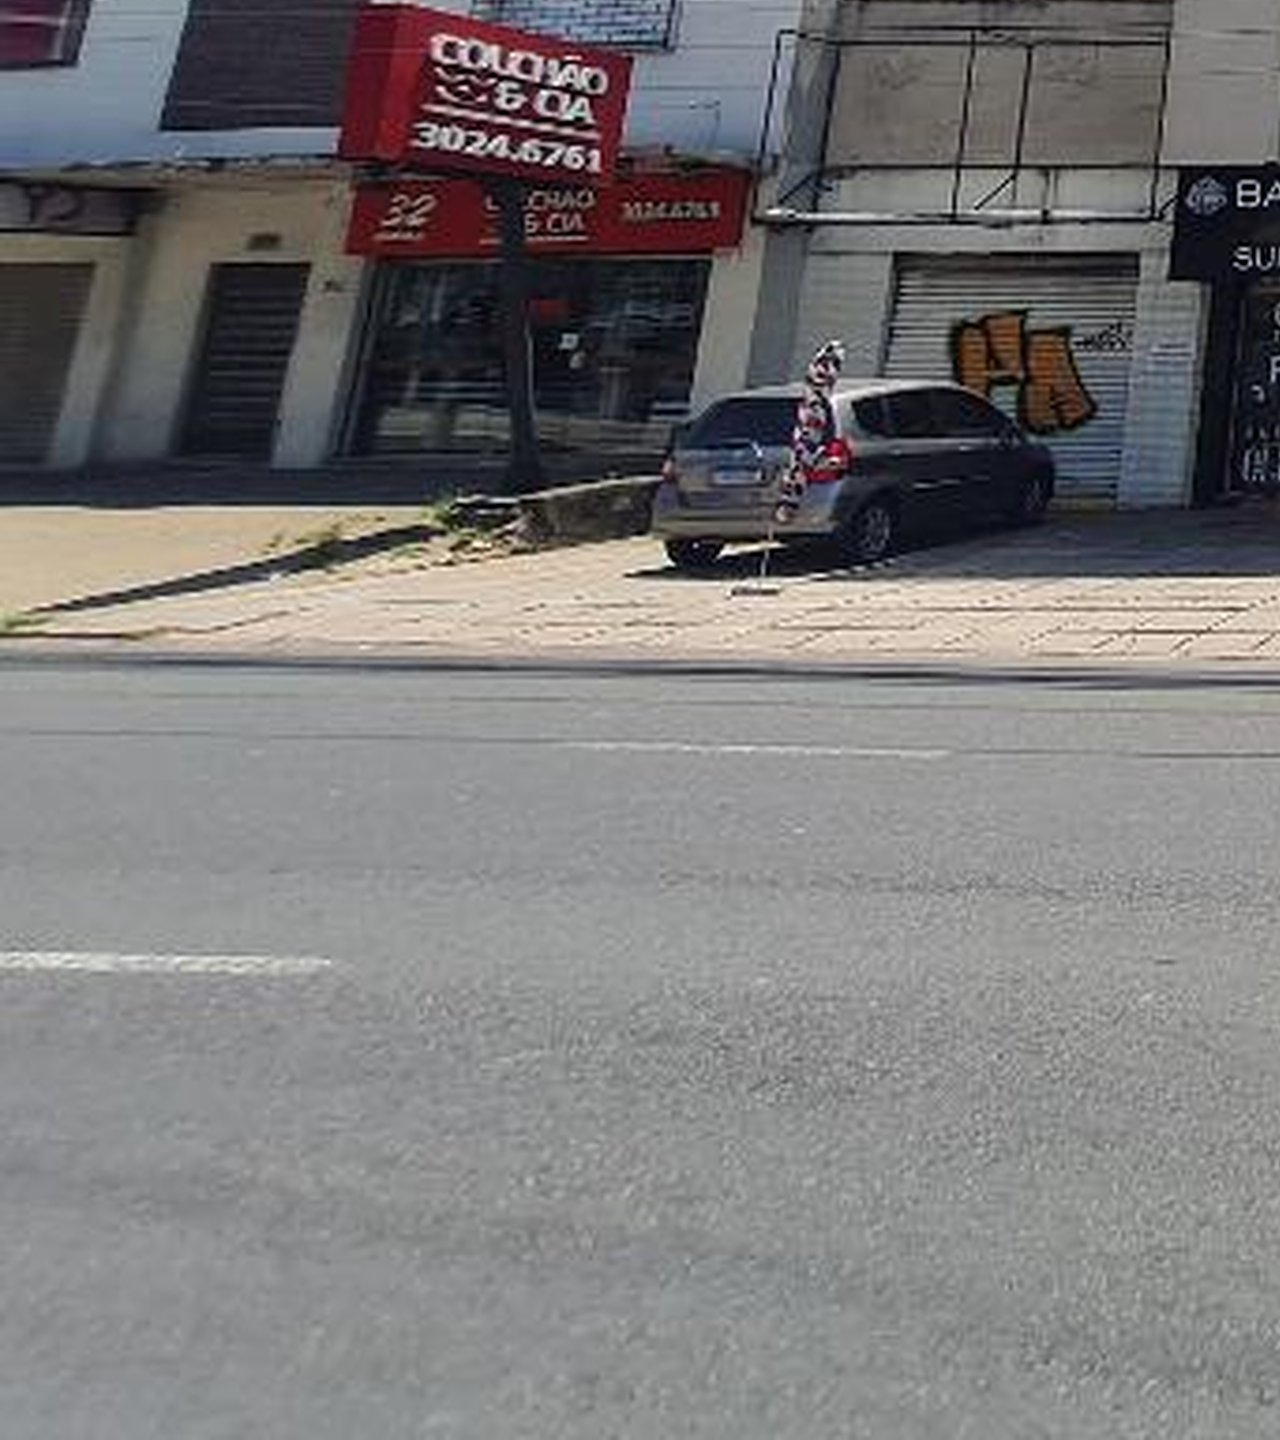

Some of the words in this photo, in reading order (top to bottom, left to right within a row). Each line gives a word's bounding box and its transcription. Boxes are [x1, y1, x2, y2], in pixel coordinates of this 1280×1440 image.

[430, 33, 608, 96] COLCHÃO
[494, 81, 520, 110] &
[536, 89, 596, 124] CIA
[412, 122, 603, 173] 3024.6761
